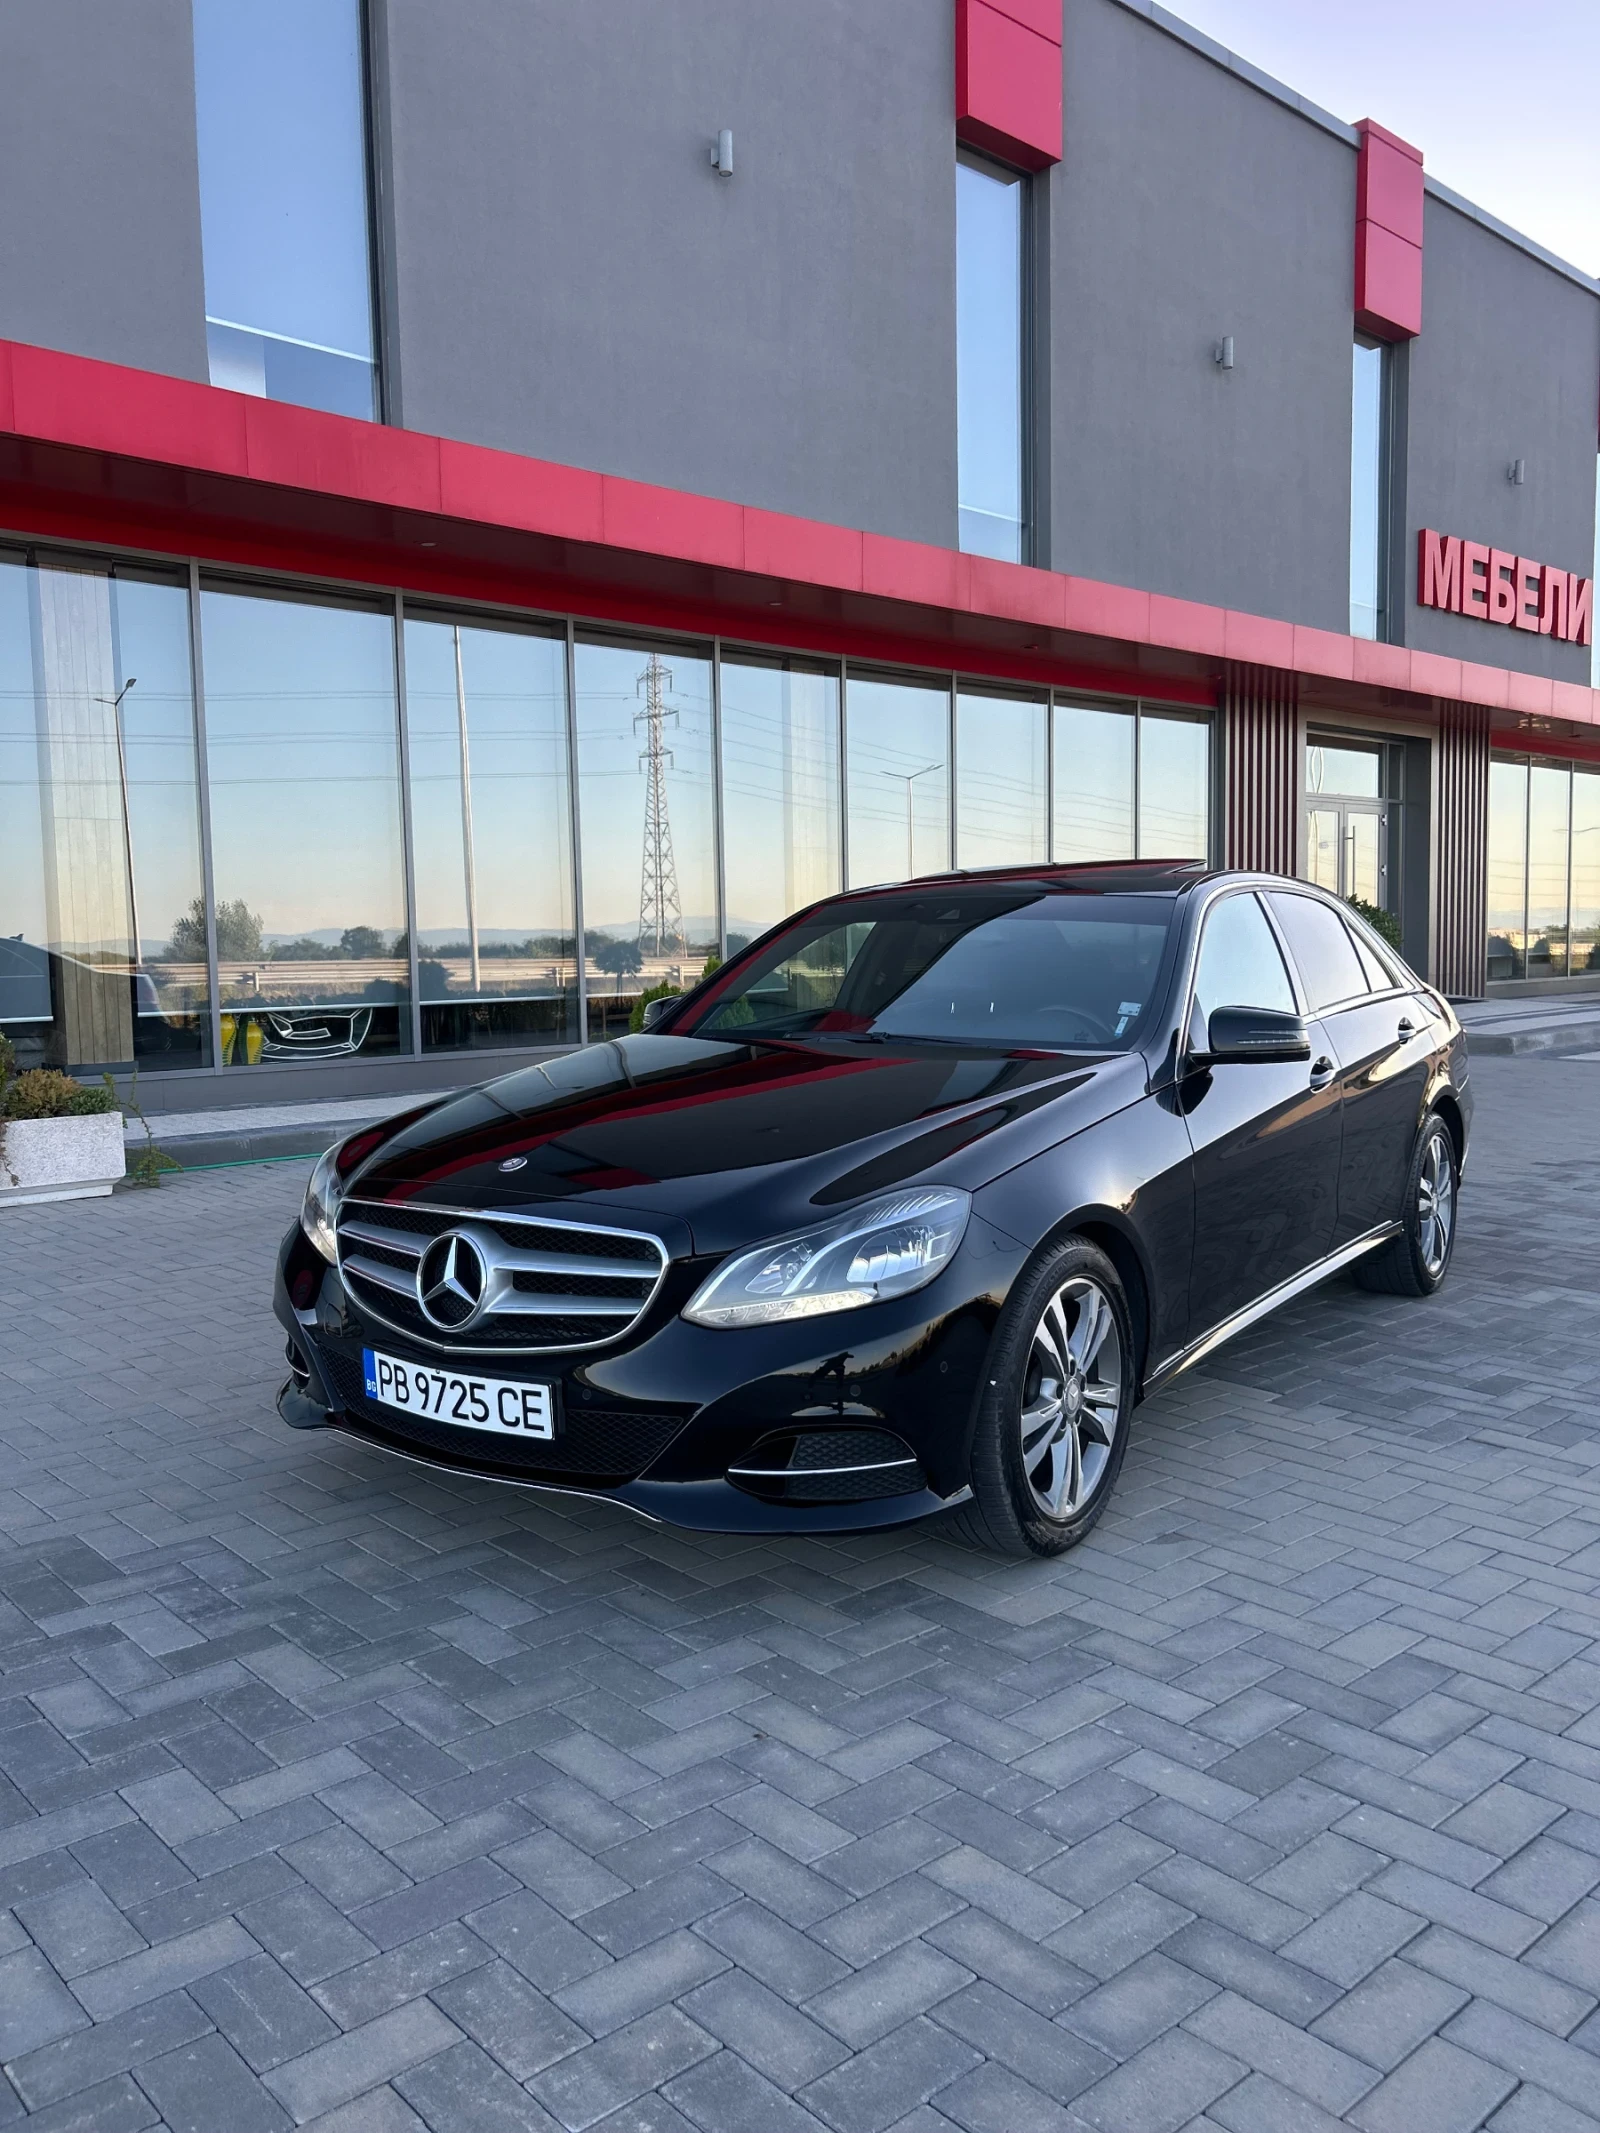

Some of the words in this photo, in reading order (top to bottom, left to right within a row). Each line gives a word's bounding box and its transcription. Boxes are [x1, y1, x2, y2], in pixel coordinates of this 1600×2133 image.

[1417, 528, 1593, 647] МЕБЕЛИ
[366, 1379, 377, 1393] BG
[378, 1359, 409, 1403] PB
[415, 1372, 489, 1422] 9725
[497, 1387, 545, 1432] CE
